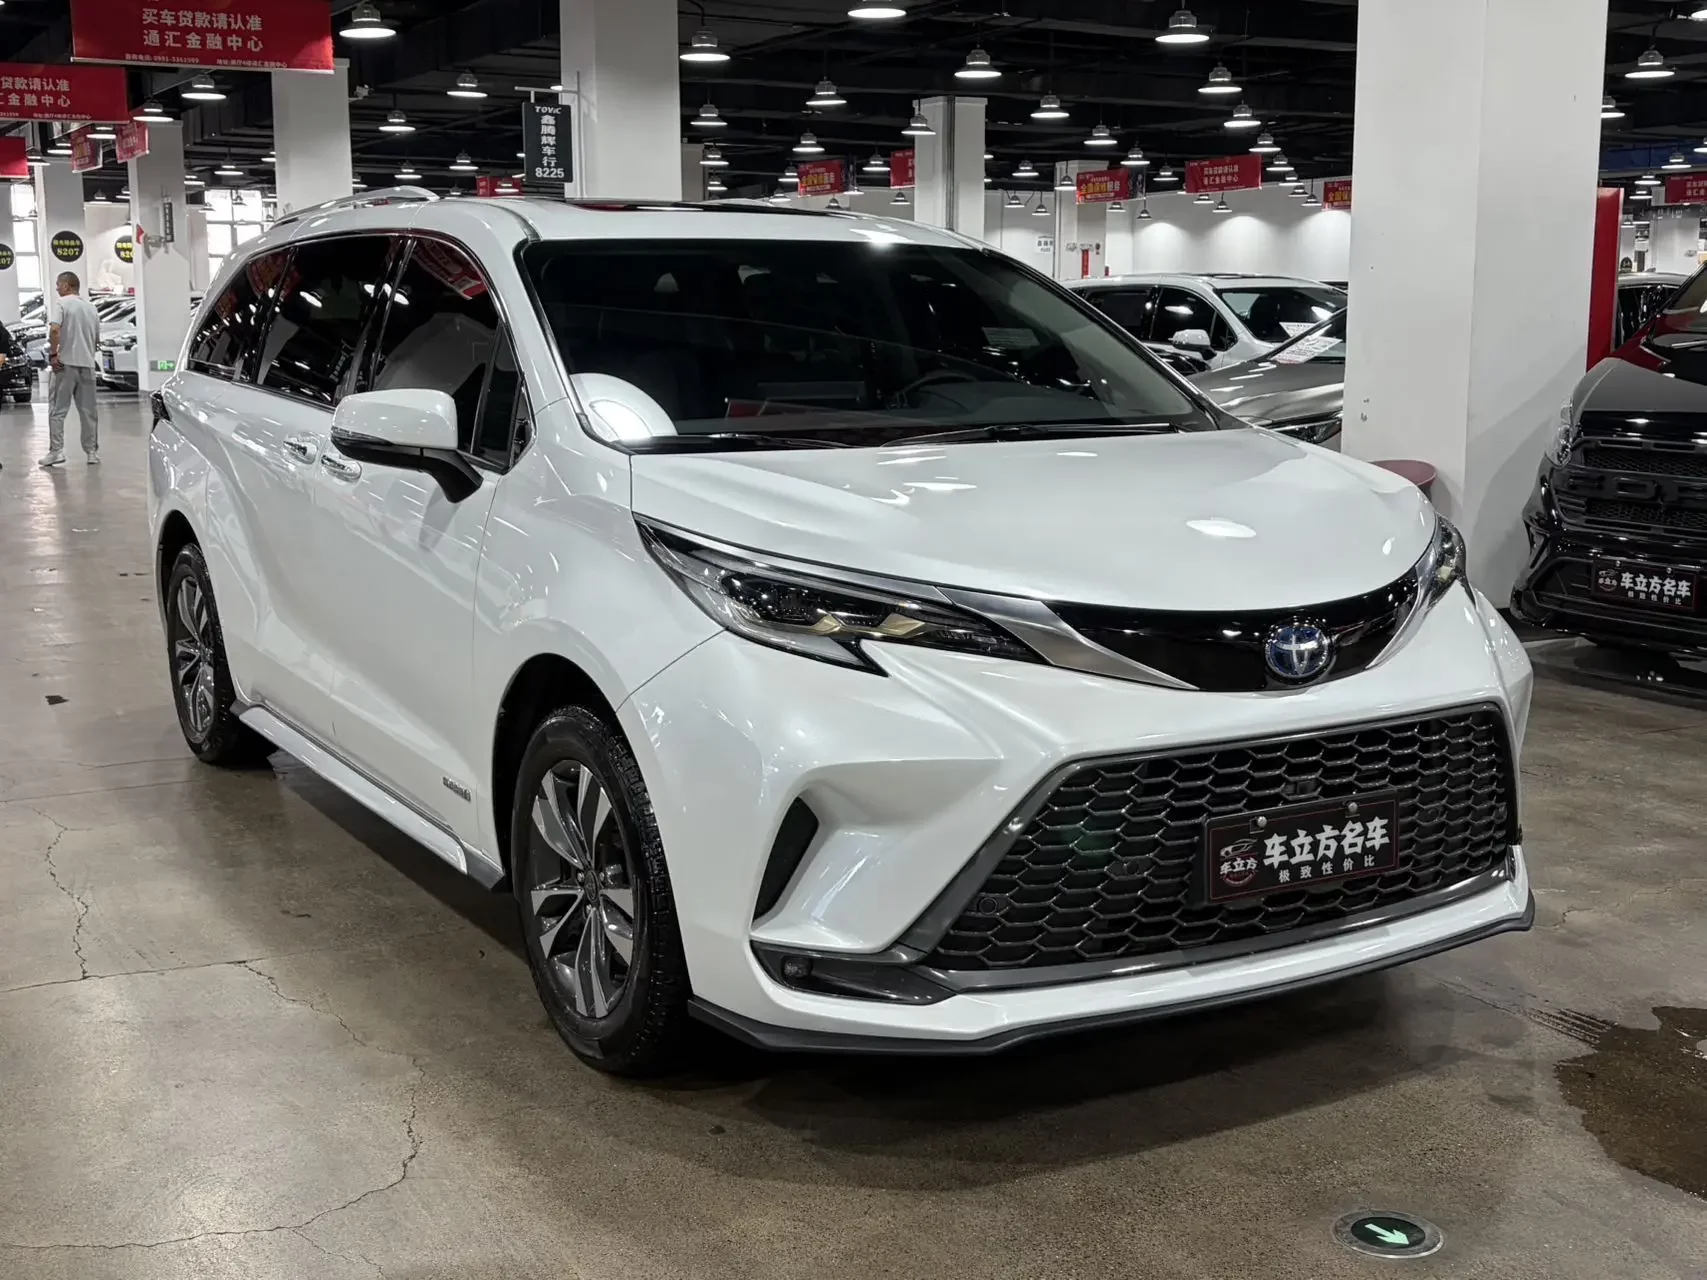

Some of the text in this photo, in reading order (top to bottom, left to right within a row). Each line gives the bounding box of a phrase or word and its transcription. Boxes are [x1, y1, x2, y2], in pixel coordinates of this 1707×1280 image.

[142, 8, 262, 31] 买车贷款请认准
[143, 29, 263, 52] 通汇金融中心
[0, 76, 70, 92] 贷款请认准
[535, 167, 565, 178] 8225
[56, 248, 80, 256] 8207
[1620, 571, 1691, 598] 车立方名车
[1263, 816, 1390, 869] 车立方名车
[1219, 856, 1258, 876] 车立方
[1278, 854, 1376, 884] 极致性价比
